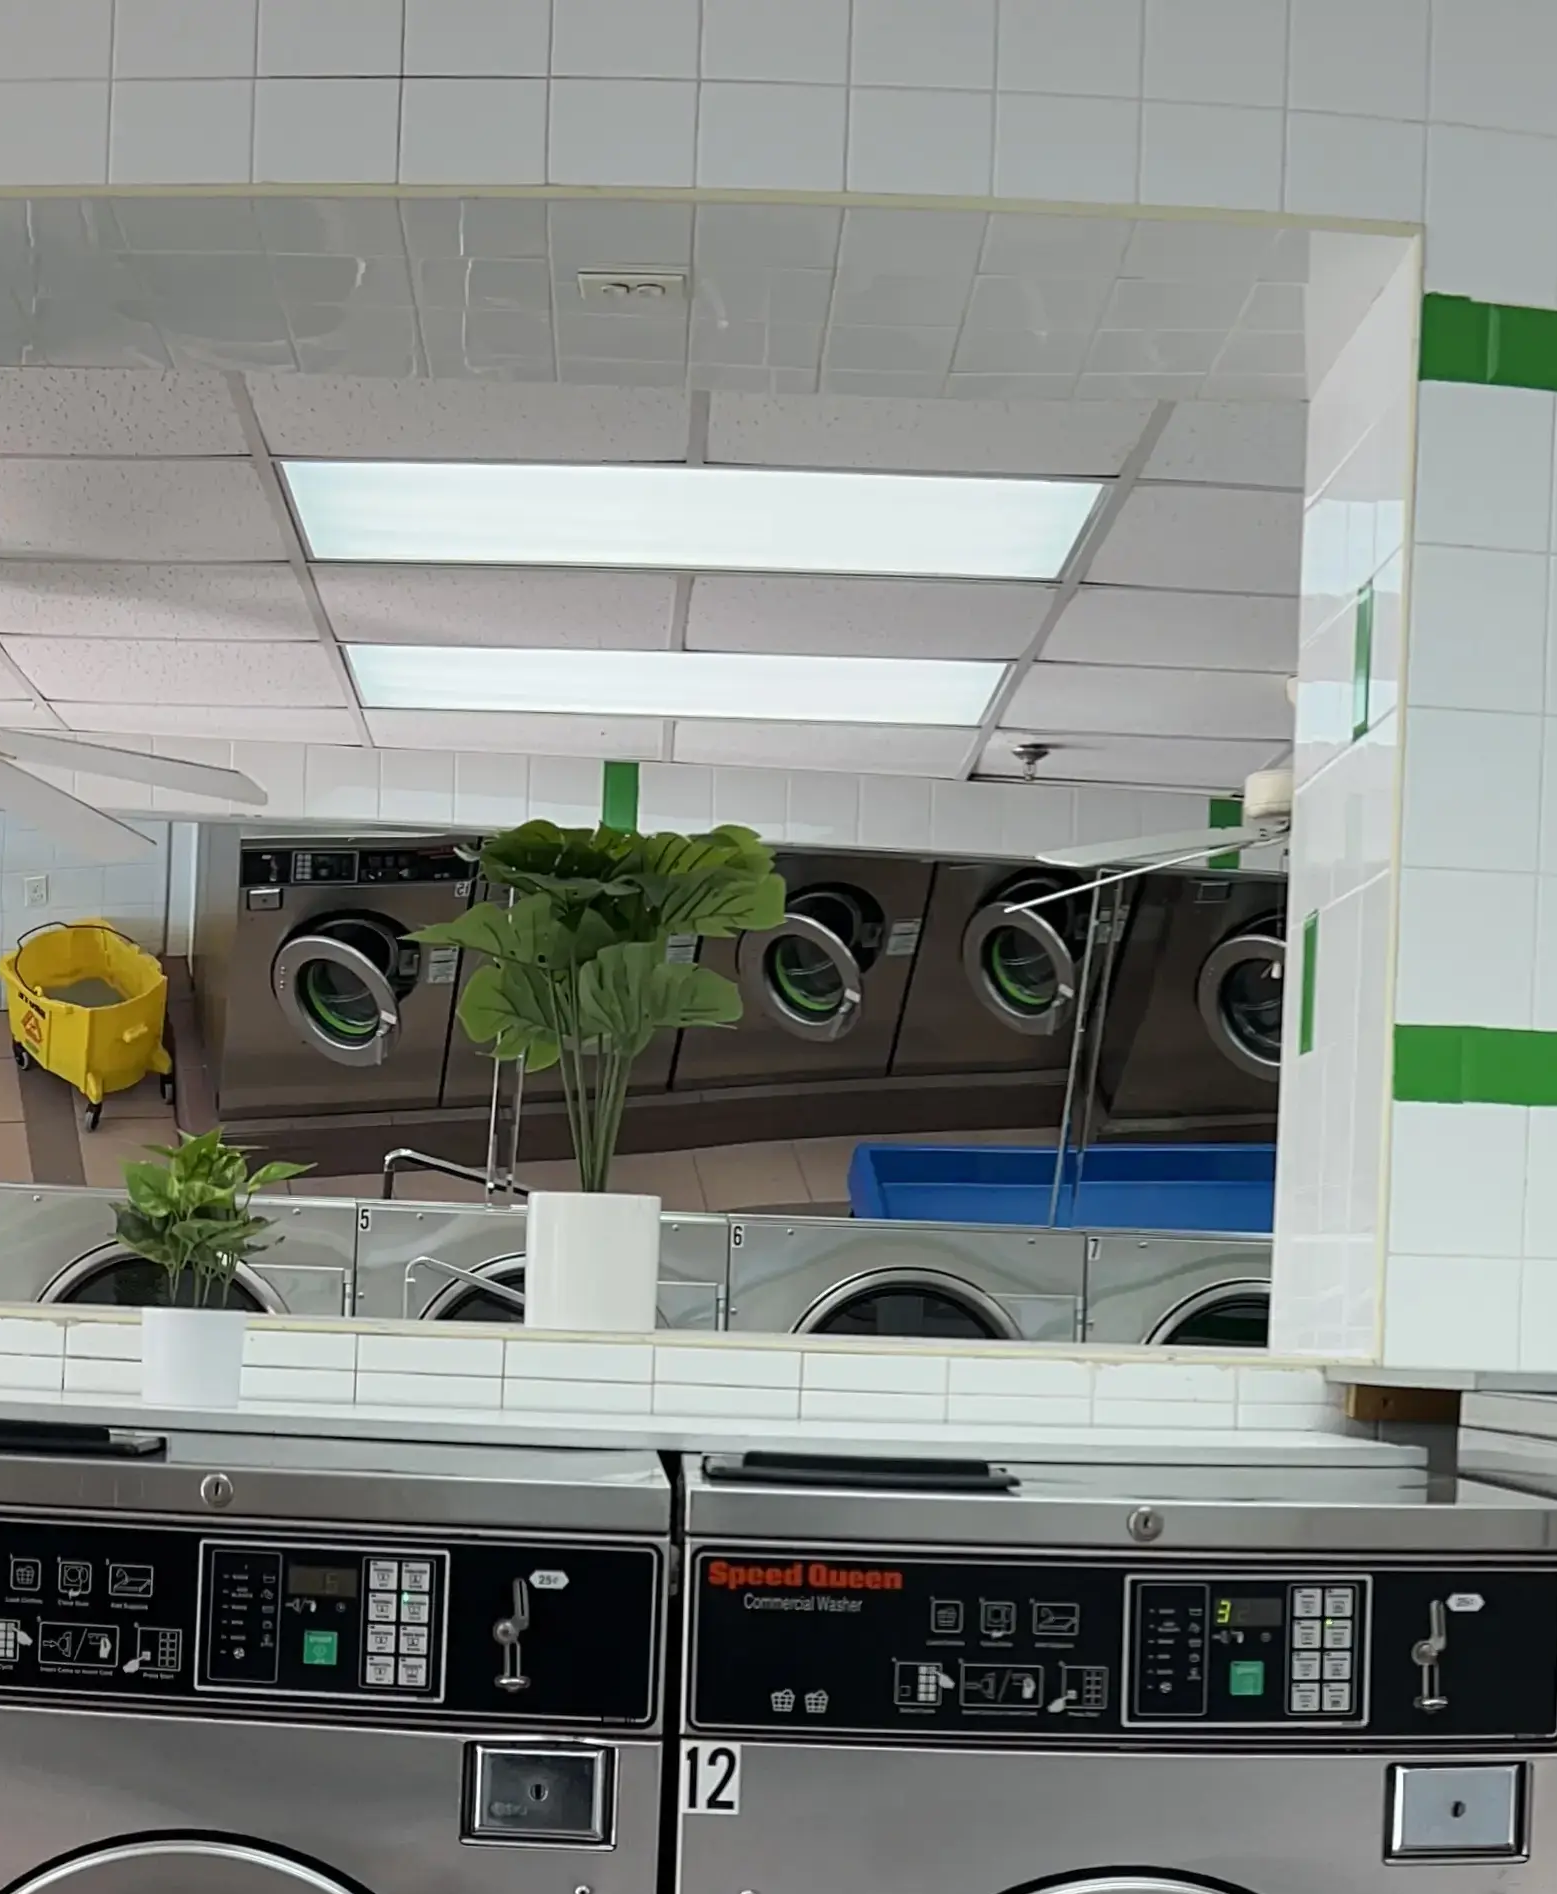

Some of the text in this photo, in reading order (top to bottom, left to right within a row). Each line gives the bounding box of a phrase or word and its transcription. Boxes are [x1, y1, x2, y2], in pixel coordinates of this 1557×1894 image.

[361, 1209, 370, 1230] 5
[733, 1226, 742, 1246] 6
[1089, 1238, 1099, 1258] 7
[709, 1561, 902, 1590] Speed Queen
[744, 1593, 862, 1613] Commercial Washer
[1217, 1599, 1232, 1624] 3
[687, 1746, 736, 1810] 12
